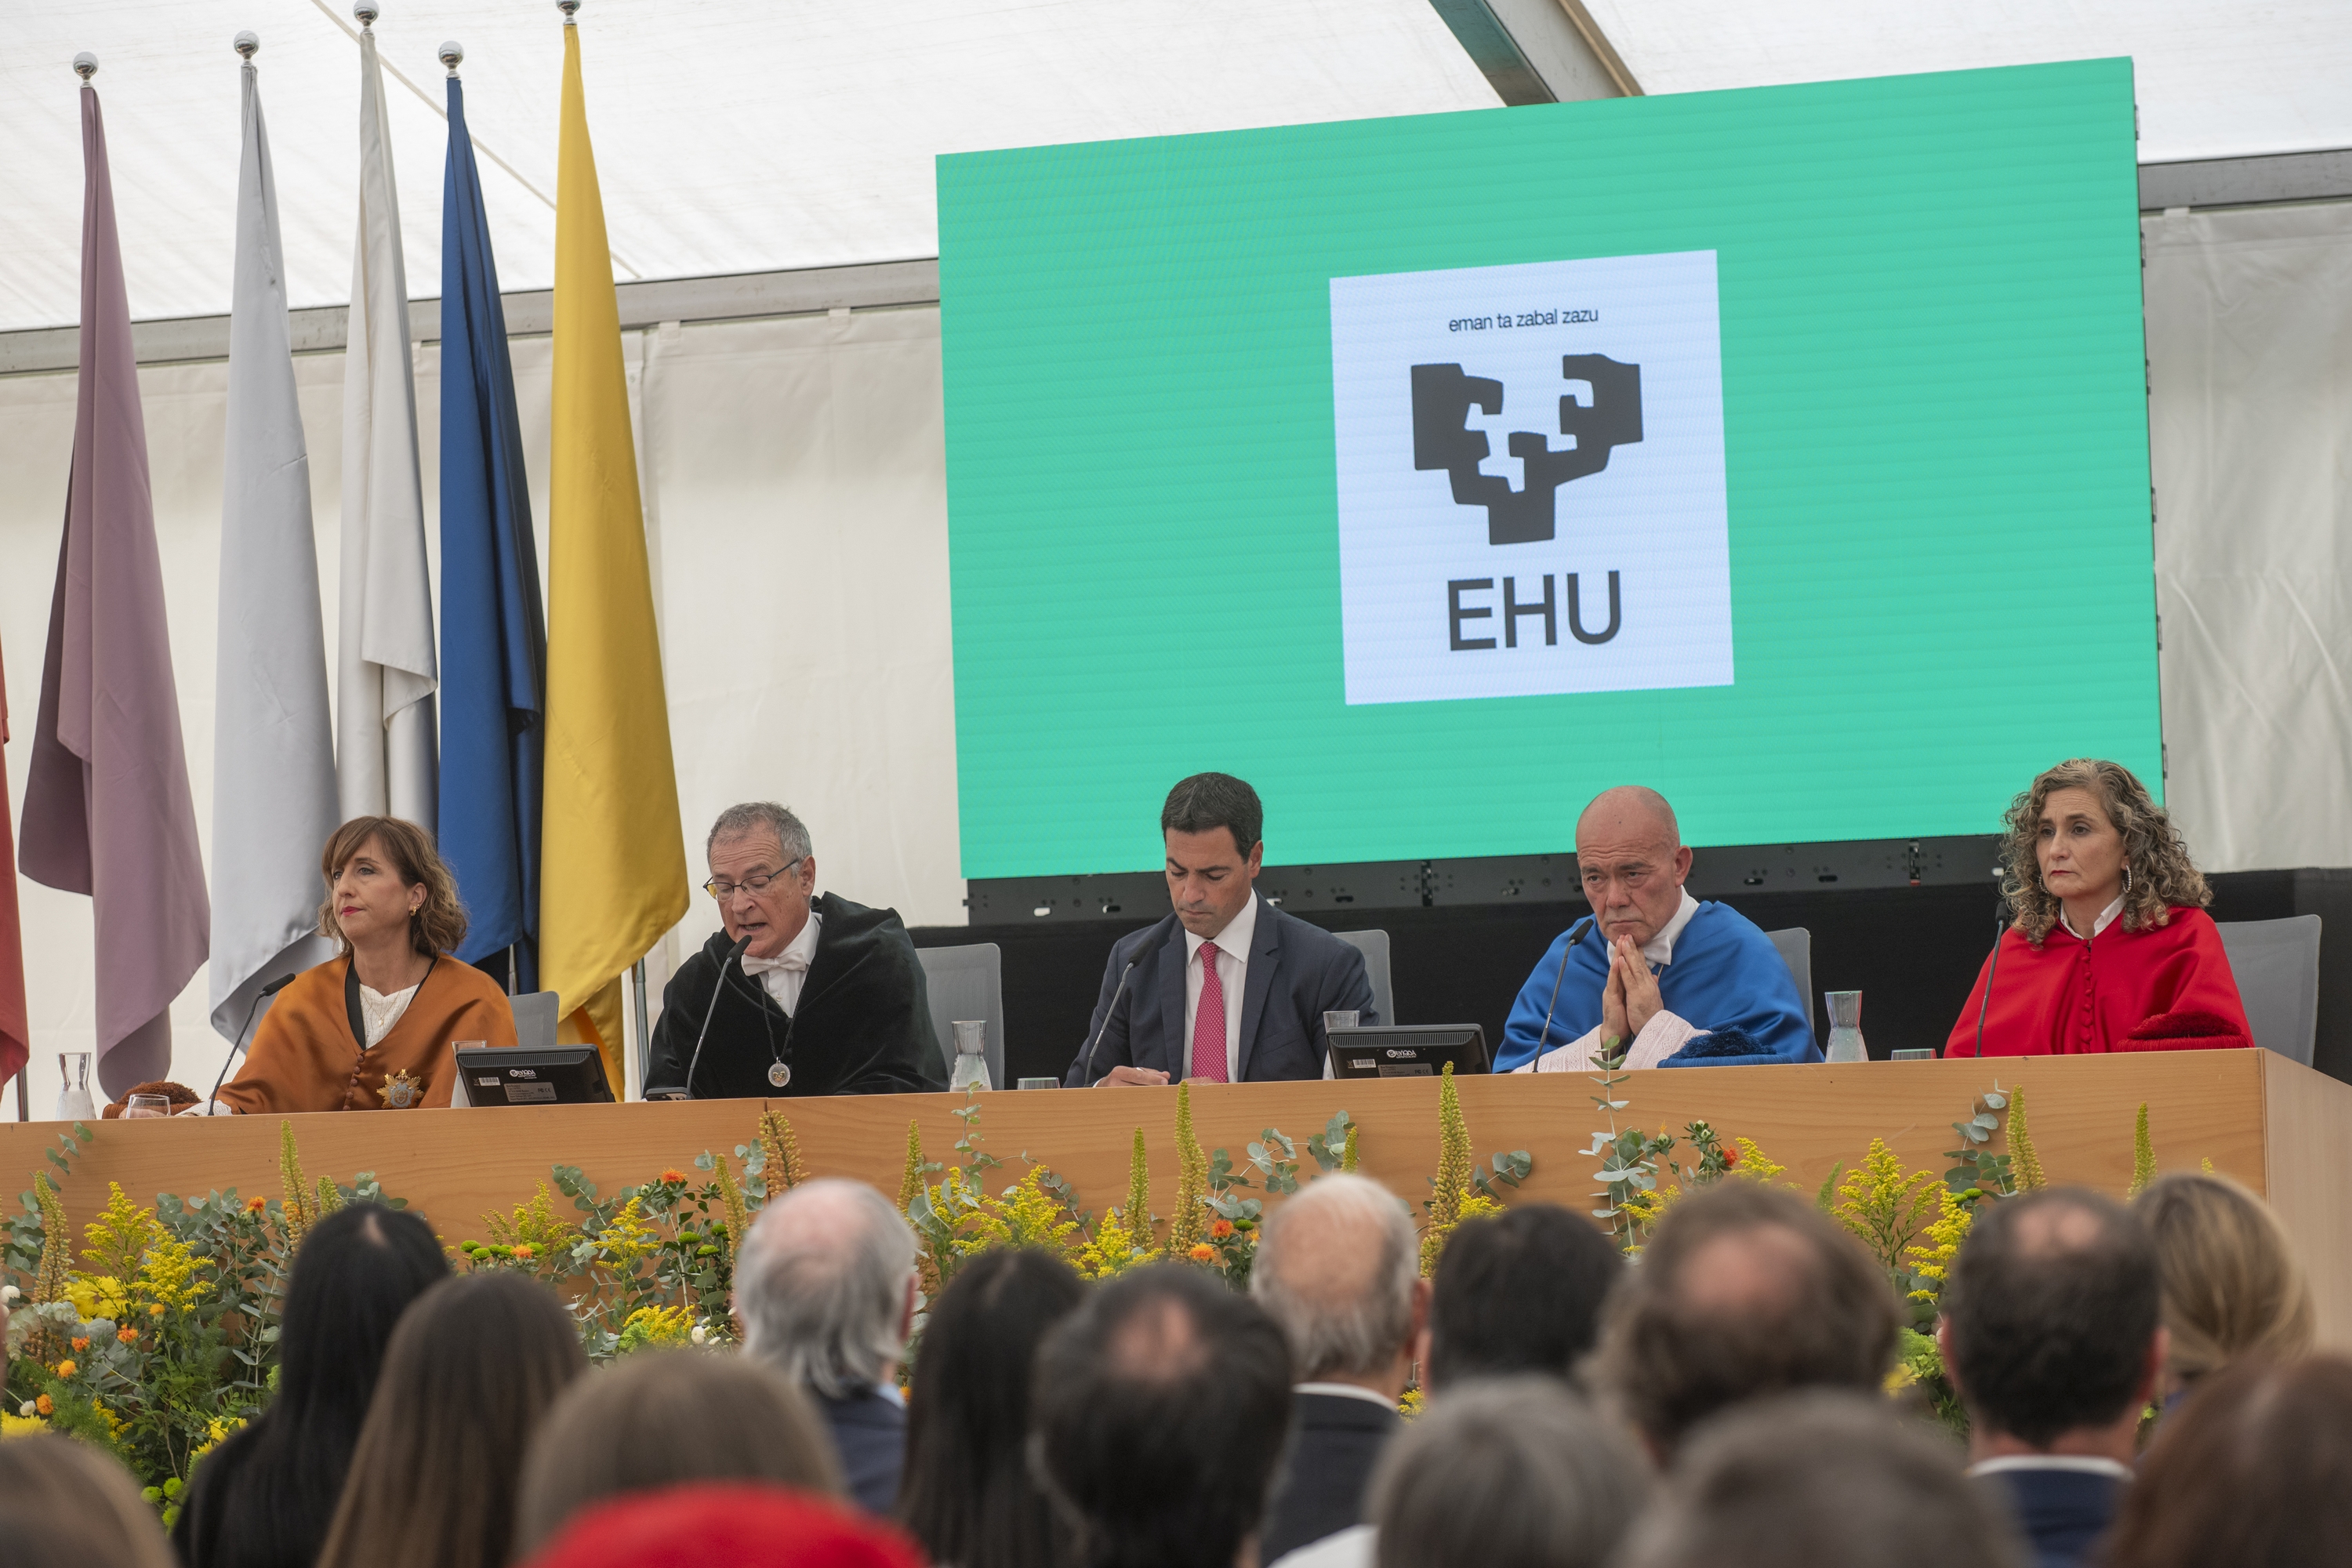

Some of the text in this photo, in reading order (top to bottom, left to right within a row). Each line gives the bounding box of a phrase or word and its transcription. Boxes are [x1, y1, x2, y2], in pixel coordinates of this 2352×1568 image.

[1449, 308, 1599, 332] eman ta zabal zazu
[1448, 570, 1622, 652] EHU
